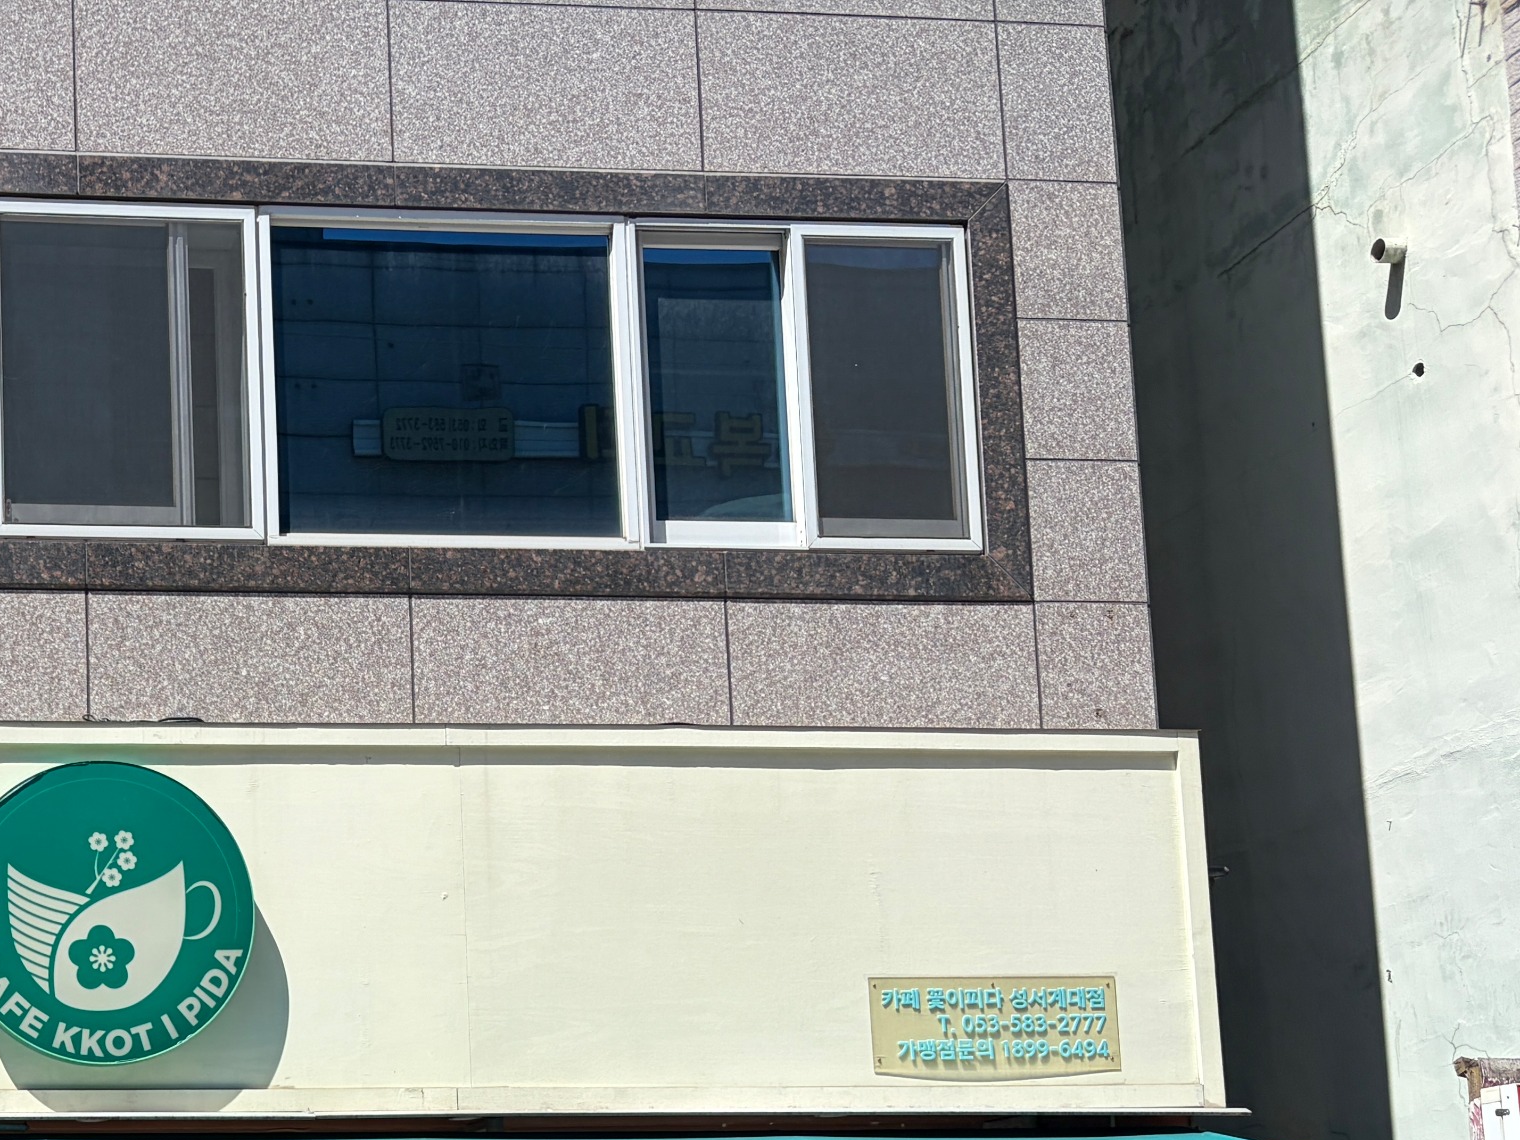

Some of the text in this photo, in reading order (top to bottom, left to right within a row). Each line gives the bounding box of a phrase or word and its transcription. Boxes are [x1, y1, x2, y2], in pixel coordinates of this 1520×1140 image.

[52, 1021, 154, 1057] KKOT
[160, 1013, 180, 1040] I
[177, 949, 244, 1027] PIDA
[881, 987, 1106, 1010] 카페 꽃이피다 성서계대점
[937, 1014, 1107, 1034] T. 053-583-2777
[897, 1039, 1109, 1061] 가맹점문의 1899-6494
